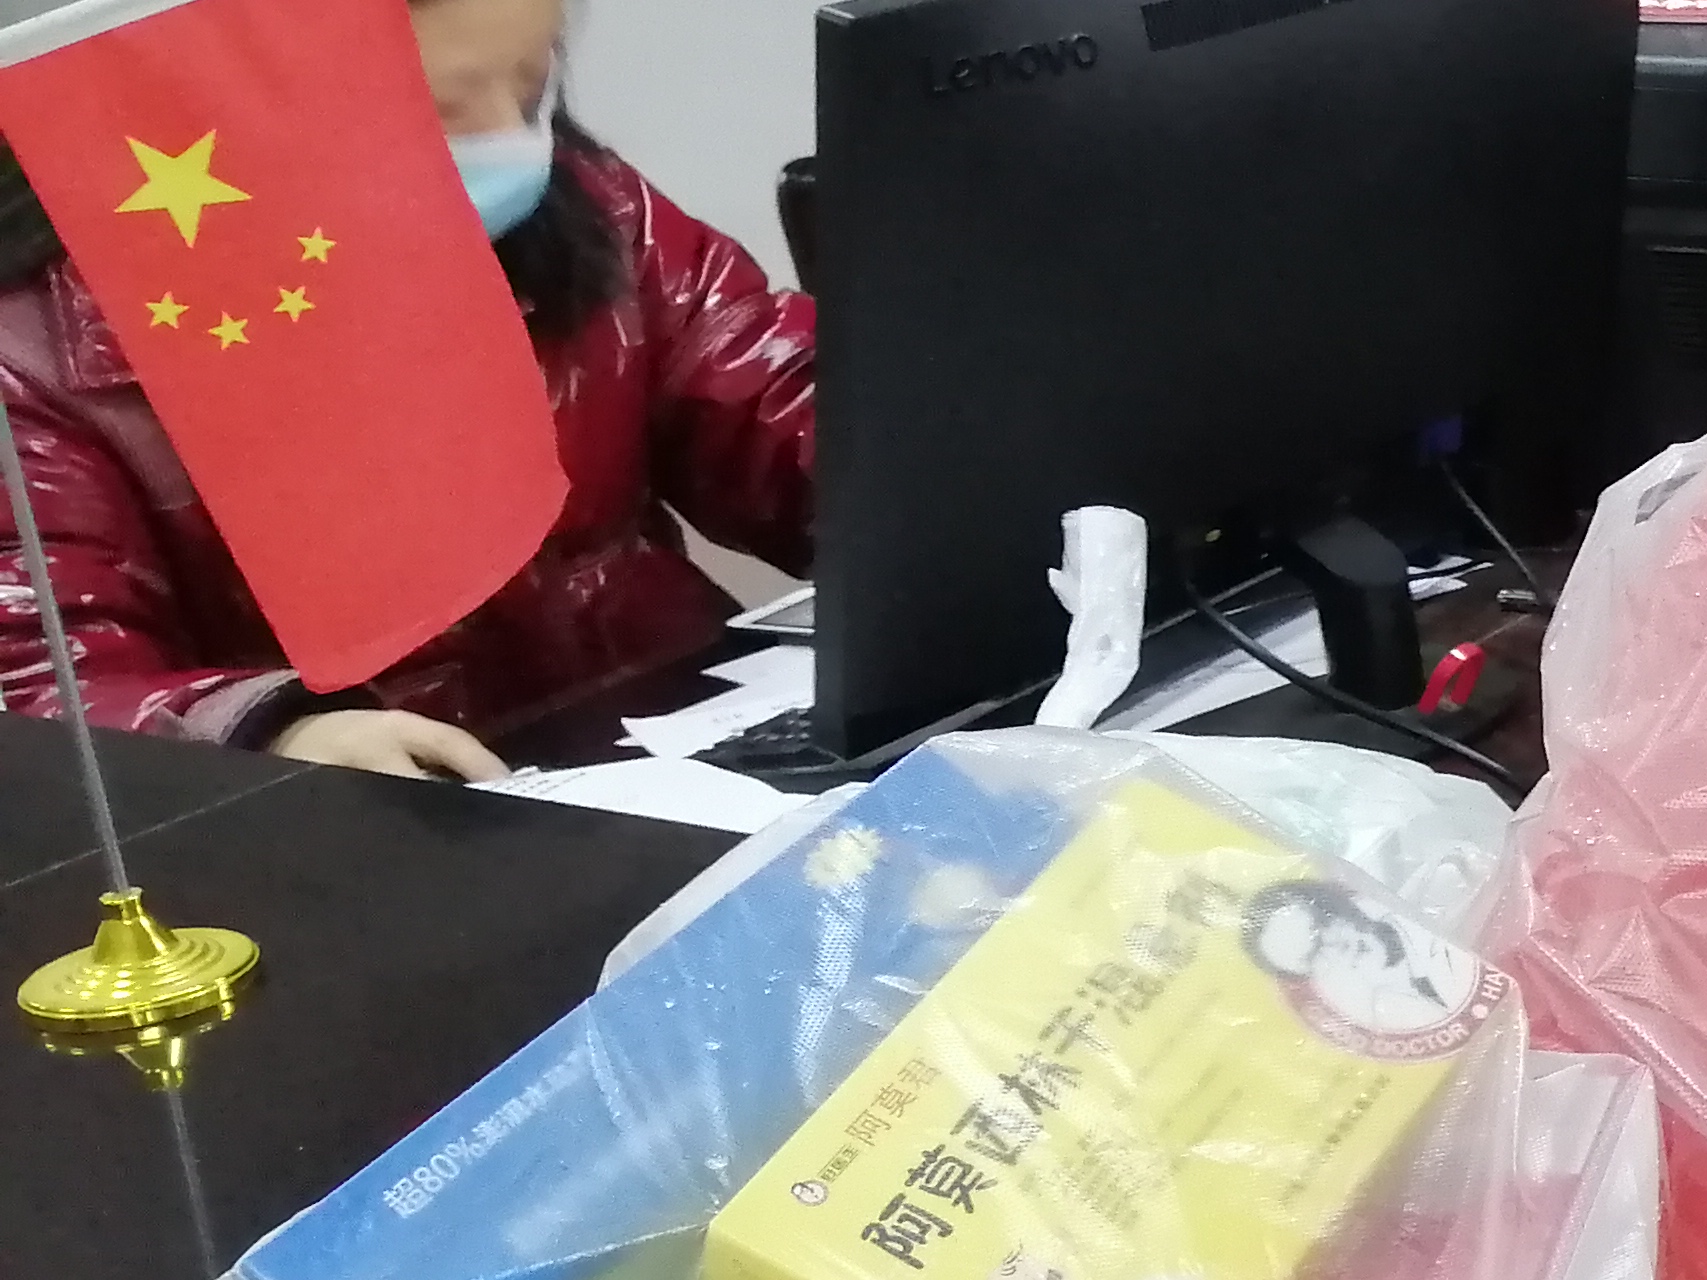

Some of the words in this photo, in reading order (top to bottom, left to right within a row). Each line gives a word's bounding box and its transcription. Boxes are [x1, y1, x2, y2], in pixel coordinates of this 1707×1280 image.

[921, 32, 1099, 94] Lenovo
[846, 1055, 942, 1148] 阿莫君
